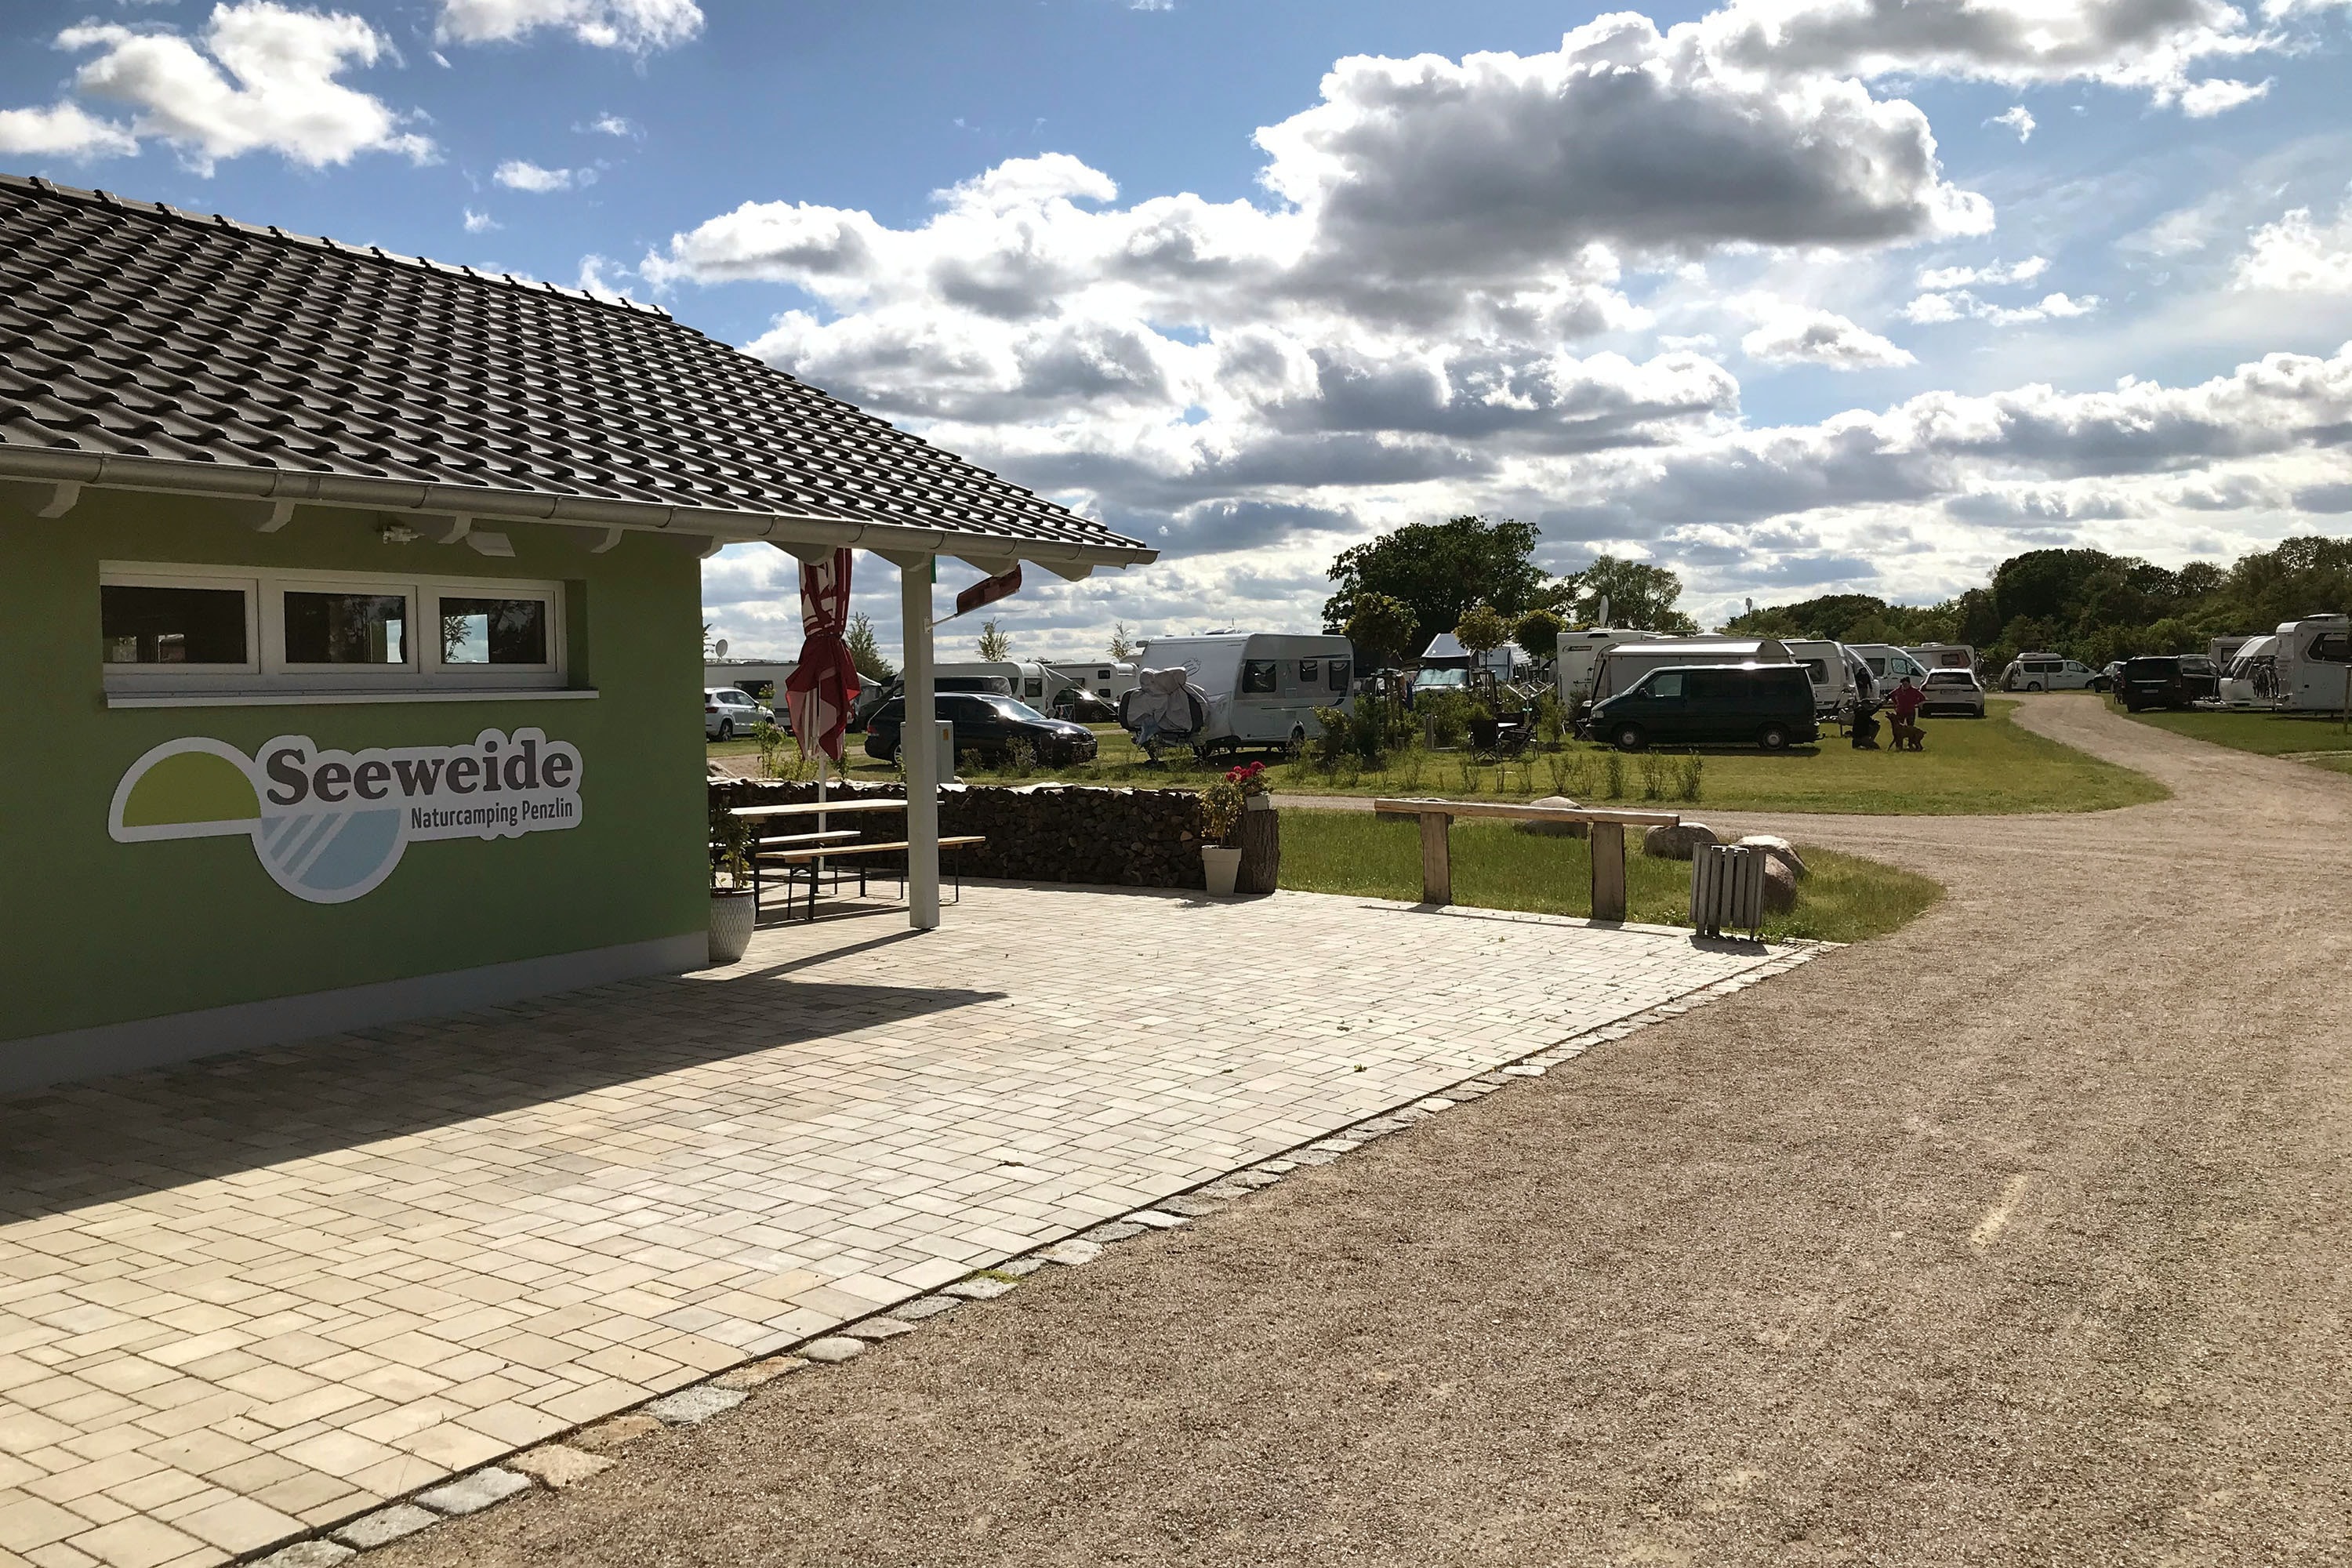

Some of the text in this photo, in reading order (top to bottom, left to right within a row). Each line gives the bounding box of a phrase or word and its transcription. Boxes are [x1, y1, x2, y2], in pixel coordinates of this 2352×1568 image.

[266, 739, 573, 806] Seeweide
[411, 797, 573, 829] Naturcamping Penzlin
